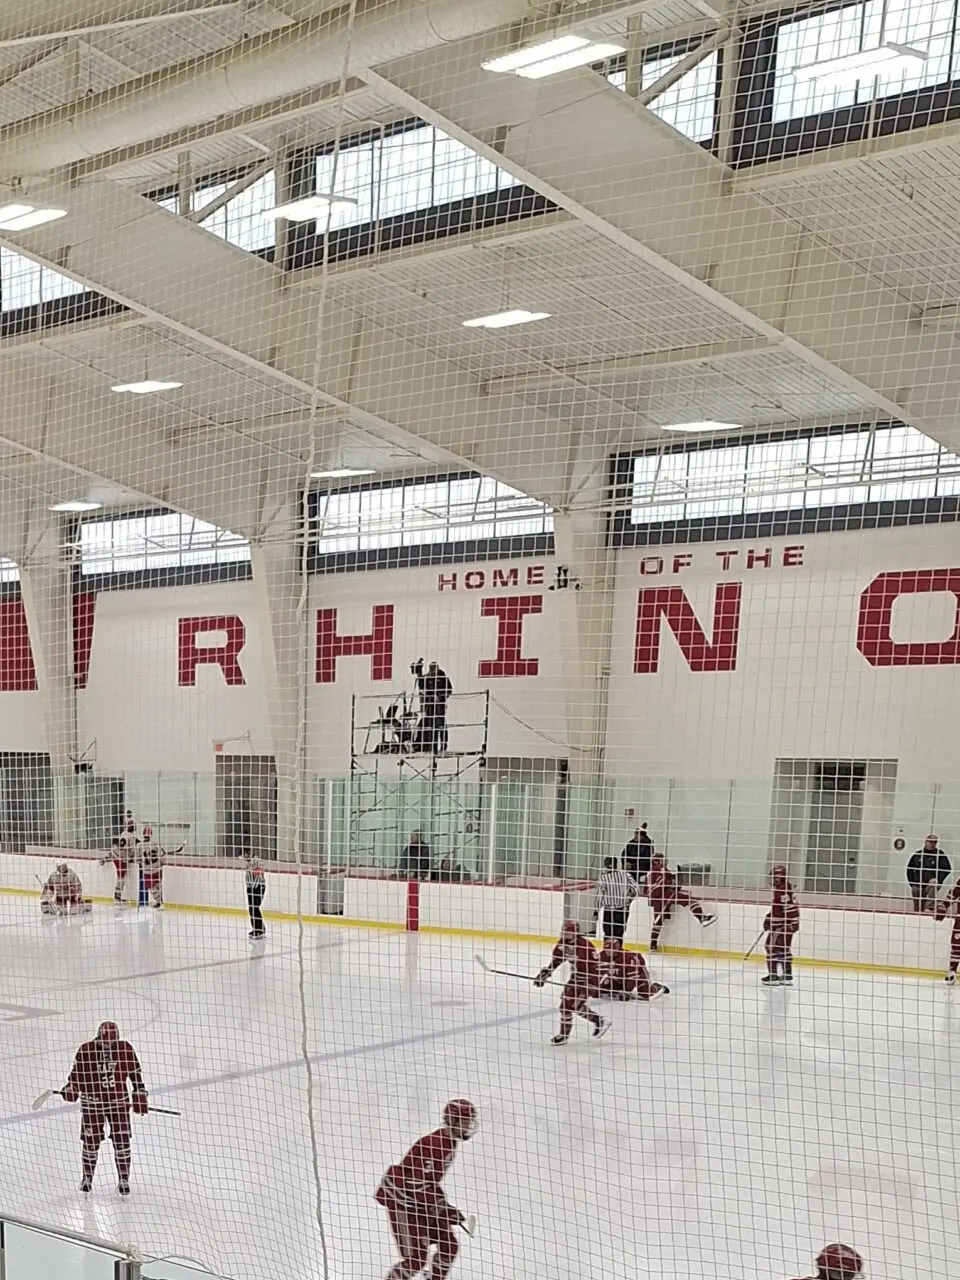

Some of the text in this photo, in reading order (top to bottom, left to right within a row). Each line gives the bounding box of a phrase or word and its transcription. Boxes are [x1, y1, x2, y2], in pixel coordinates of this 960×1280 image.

[437, 545, 804, 591] HOME OF THE
